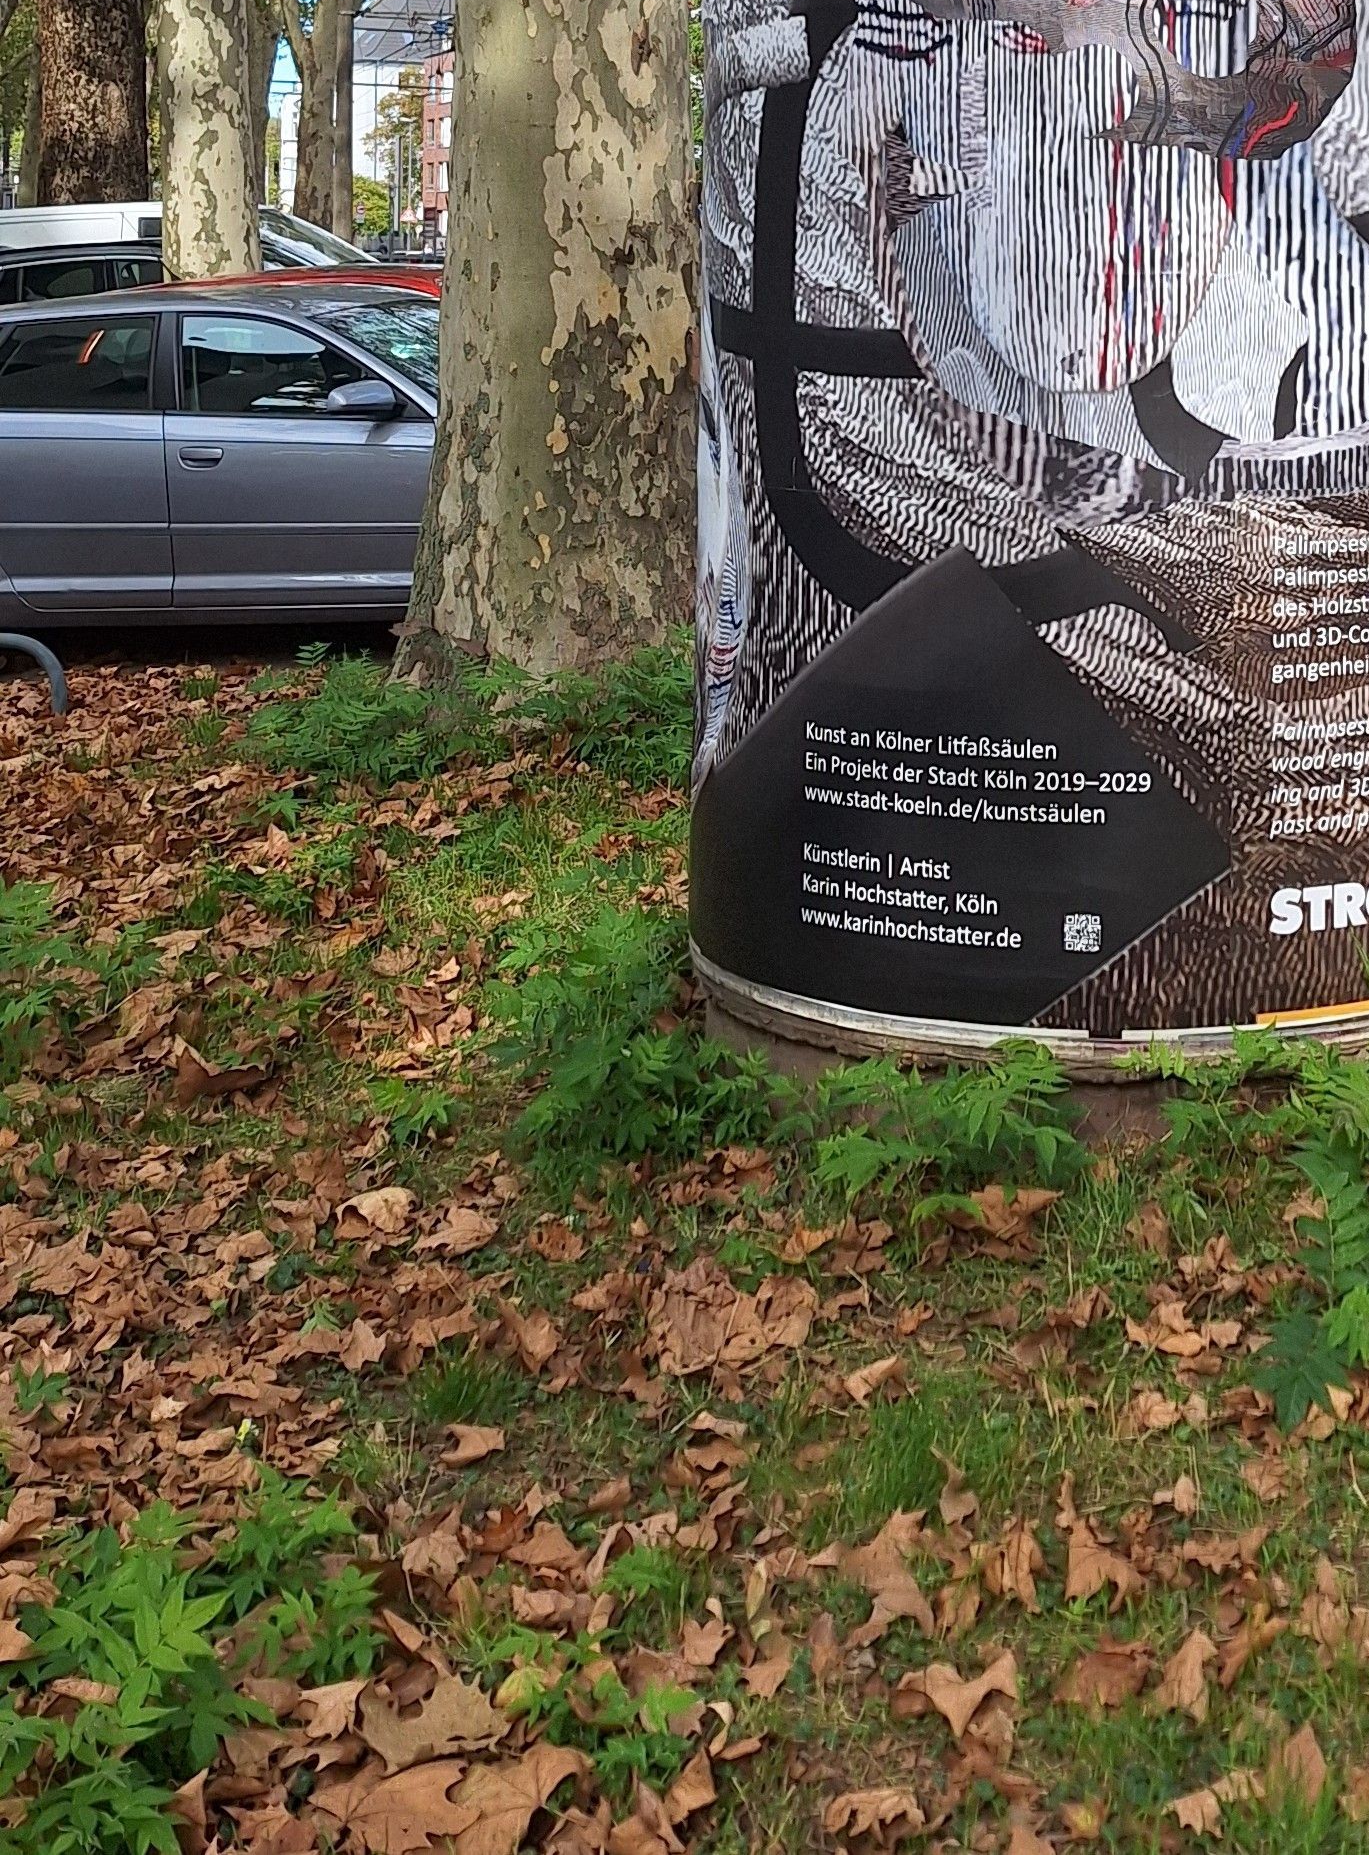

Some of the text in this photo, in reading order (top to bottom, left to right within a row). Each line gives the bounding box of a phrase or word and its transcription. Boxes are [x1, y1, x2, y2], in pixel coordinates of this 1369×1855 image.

[1272, 598, 1307, 617] des
[1272, 627, 1311, 648] und
[805, 720, 1057, 760] Kunst an Kölner Litfaßsäulen
[805, 751, 827, 772] Ein
[831, 755, 889, 781] Projekt
[893, 761, 924, 783] der
[927, 766, 978, 788] Stadt
[984, 769, 1028, 791] Köln
[1272, 749, 1326, 773] wood
[804, 785, 1106, 824] www.stadt-koeln.de/kunstsäulen
[1308, 778, 1345, 801] and
[1270, 817, 1314, 840] past
[1318, 808, 1354, 831] and
[803, 842, 881, 873] Künstlerin
[900, 856, 951, 880] Artist
[802, 872, 998, 915] Karin Hochstatter, Köln
[801, 906, 1022, 949] www.karinhochstatter.de
